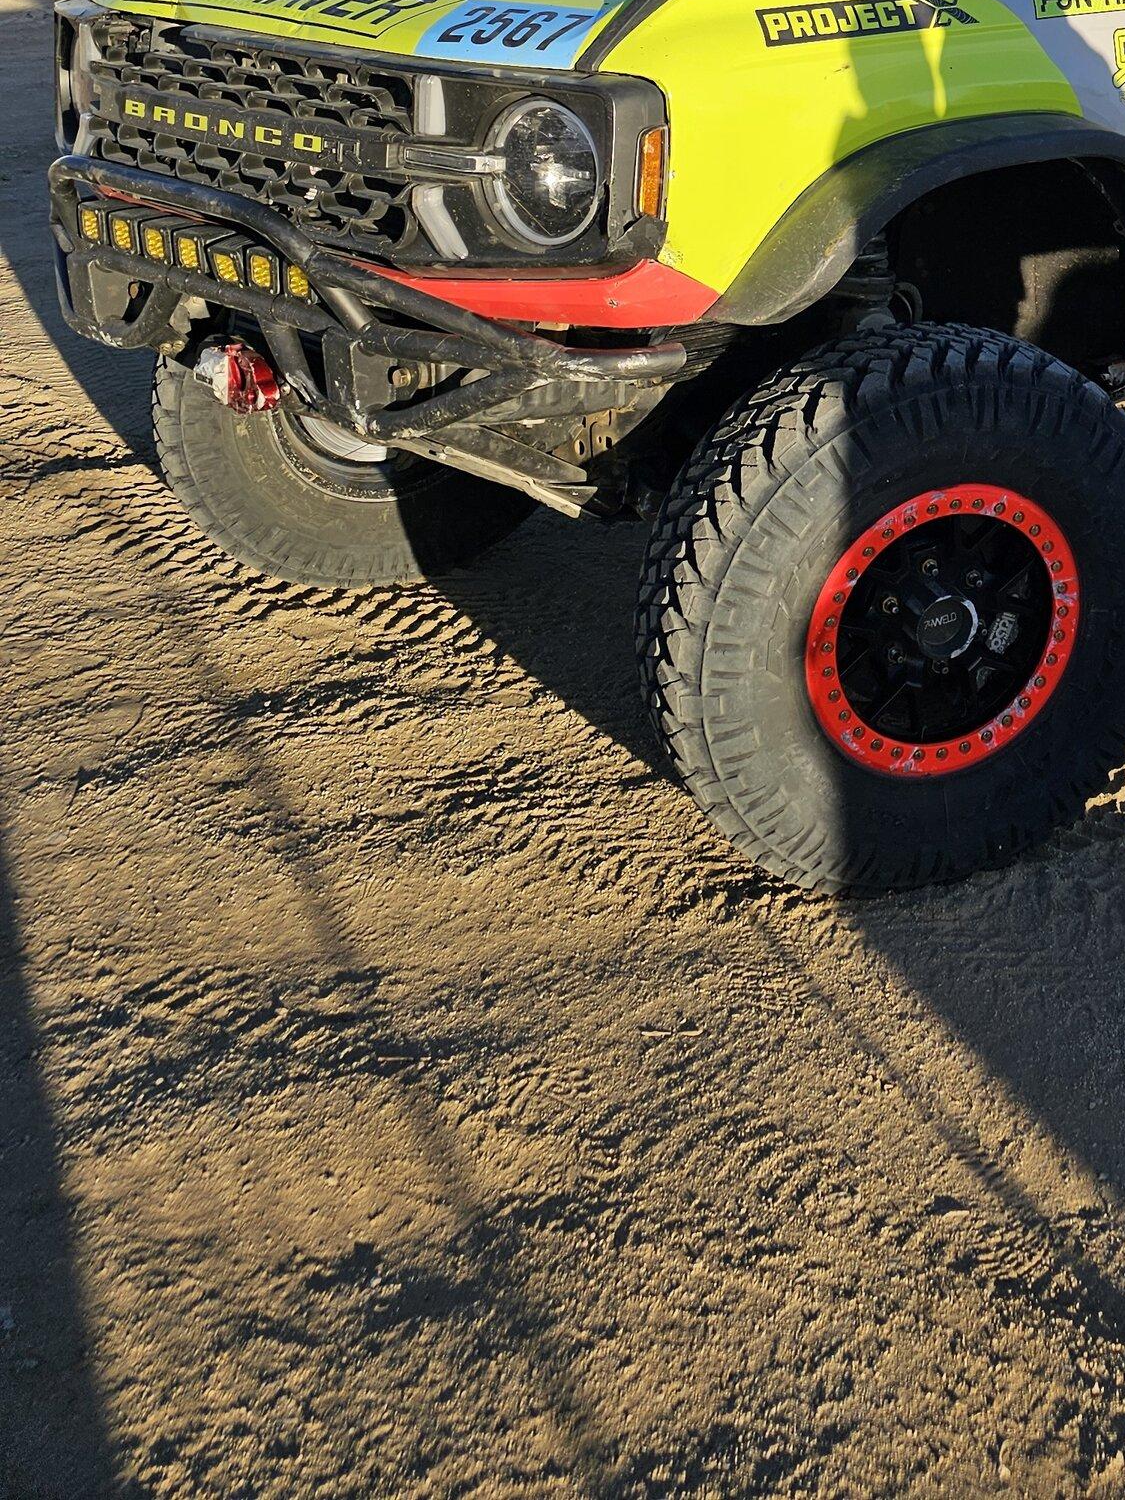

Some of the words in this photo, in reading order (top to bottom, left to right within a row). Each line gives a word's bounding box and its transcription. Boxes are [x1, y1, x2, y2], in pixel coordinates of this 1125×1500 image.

[437, 6, 595, 51] 2567
[762, 0, 920, 41] PROJECT
[125, 99, 323, 153] BRONCO
